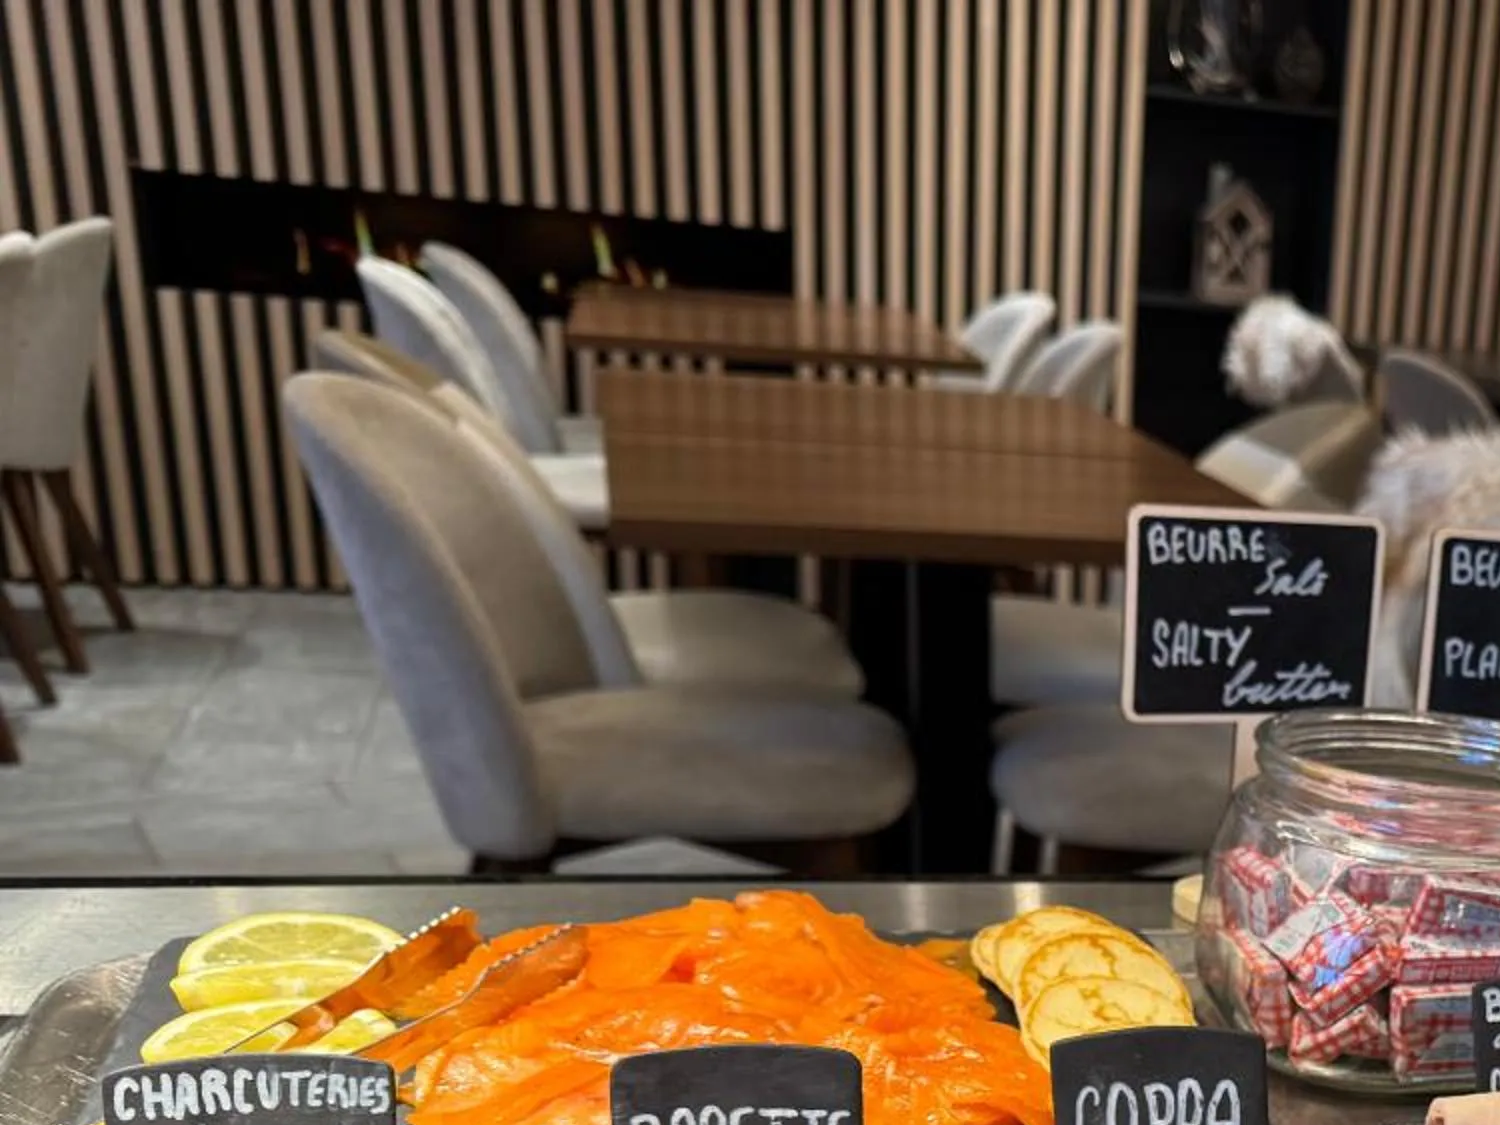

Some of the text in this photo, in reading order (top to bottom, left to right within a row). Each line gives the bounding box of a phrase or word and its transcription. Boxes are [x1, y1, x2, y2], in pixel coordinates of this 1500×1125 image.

[1147, 522, 1266, 565] BEURRE
[1151, 618, 1351, 708] SALTY butter
[113, 1068, 391, 1121] CHARCUTERIES
